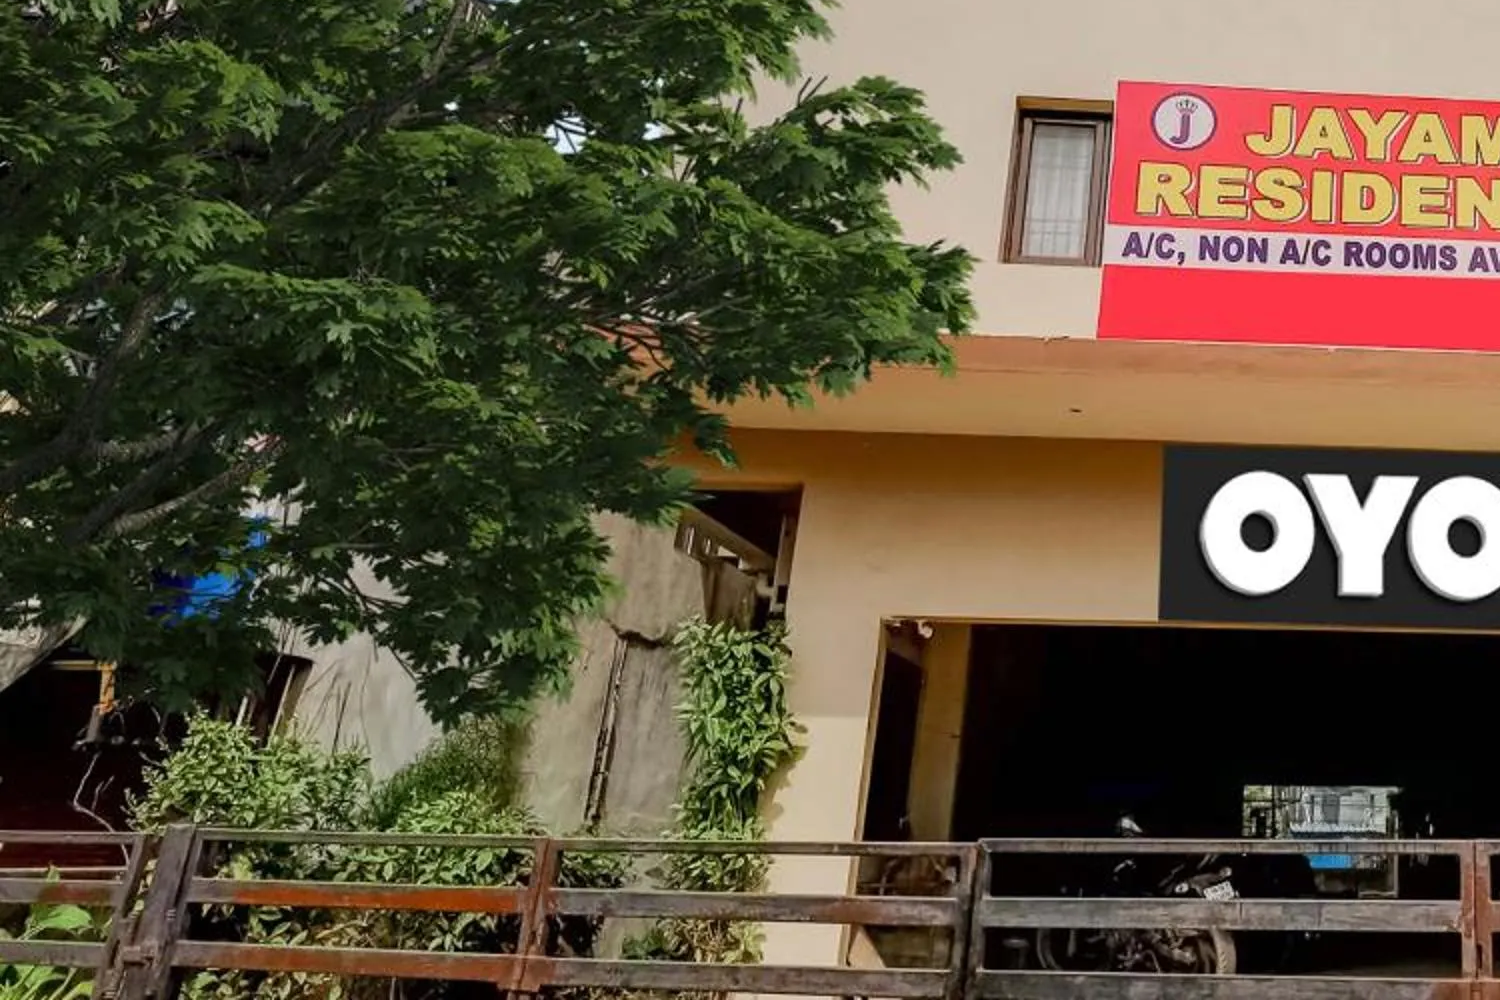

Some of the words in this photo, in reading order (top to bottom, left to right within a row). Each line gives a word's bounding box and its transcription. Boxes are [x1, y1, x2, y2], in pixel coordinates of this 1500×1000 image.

[1121, 231, 1185, 265] A/C,
[1198, 235, 1269, 264] NON
[1279, 238, 1332, 267] A/C
[1343, 241, 1458, 271] ROOMS
